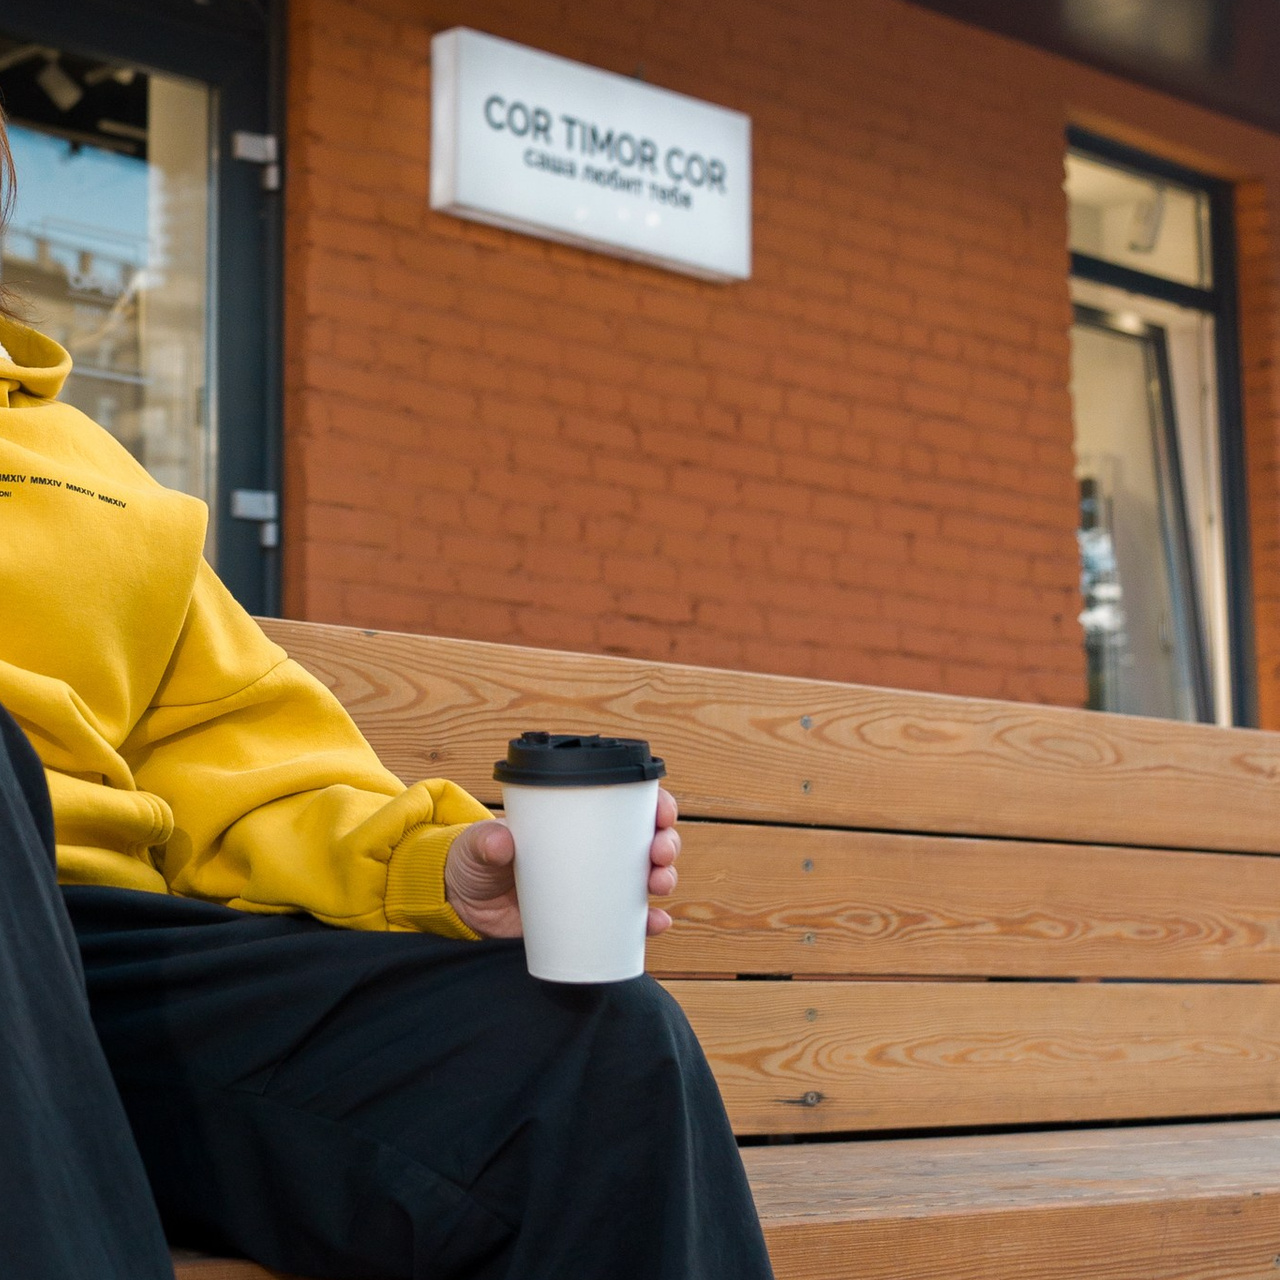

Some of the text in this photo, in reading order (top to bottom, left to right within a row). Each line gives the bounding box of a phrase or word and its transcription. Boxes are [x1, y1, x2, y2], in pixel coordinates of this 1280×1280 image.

[483, 95, 727, 194] COR TIMOR COR
[30, 475, 62, 487] MMXIV
[66, 483, 95, 497] MMXIV
[98, 493, 126, 508] MMXIV
